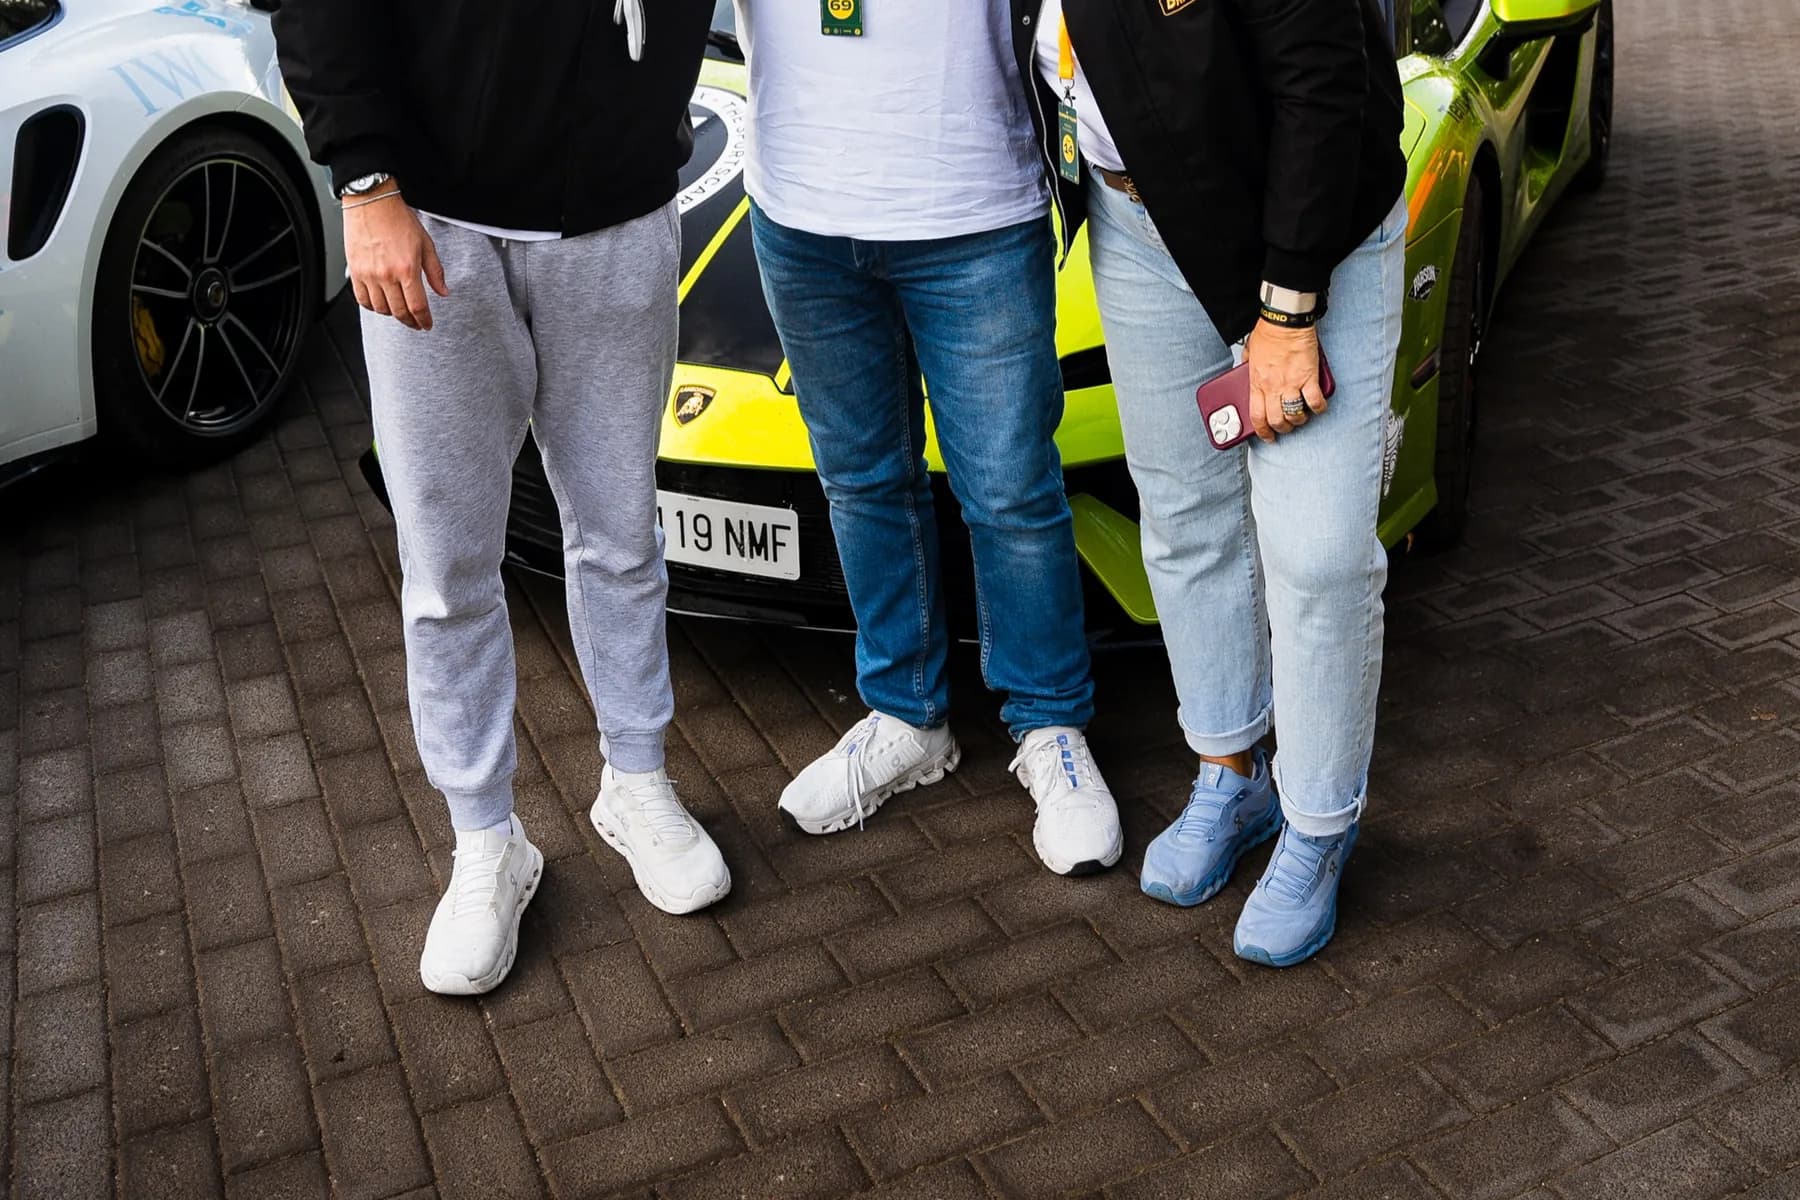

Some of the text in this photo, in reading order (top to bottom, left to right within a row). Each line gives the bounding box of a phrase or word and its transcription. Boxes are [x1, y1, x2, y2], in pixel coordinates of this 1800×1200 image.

[830, 0, 852, 11] 69
[1260, 308, 1288, 322] GEND
[676, 510, 713, 552] 19
[724, 516, 792, 564] NMF
